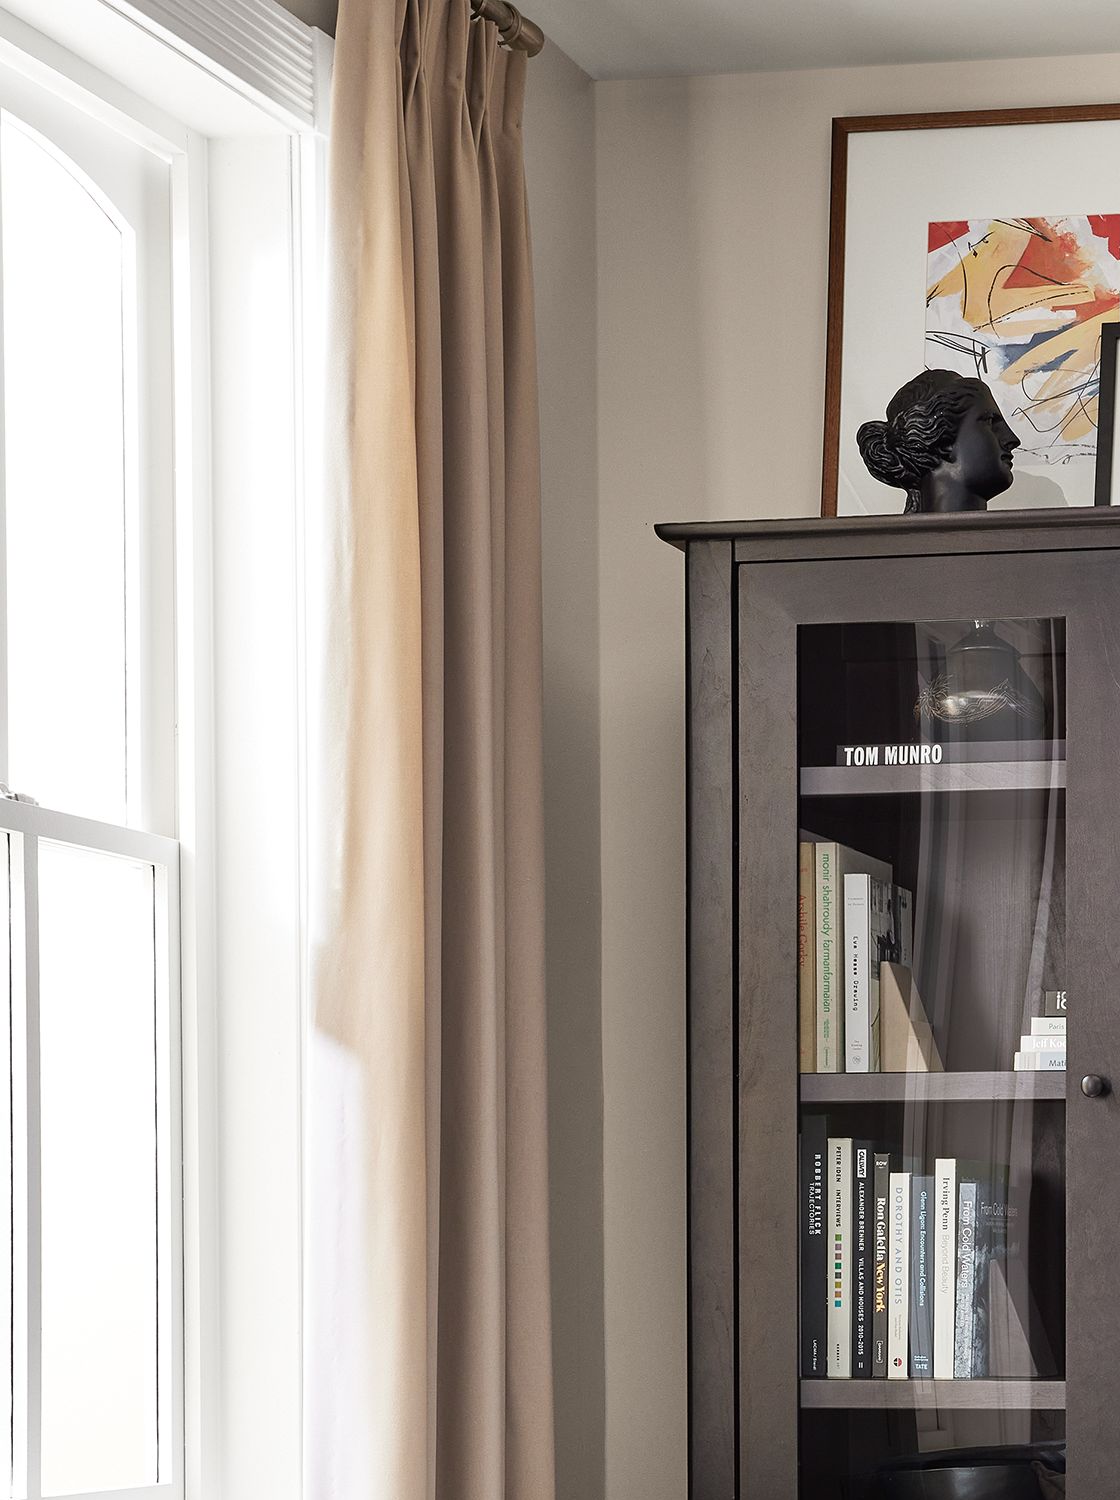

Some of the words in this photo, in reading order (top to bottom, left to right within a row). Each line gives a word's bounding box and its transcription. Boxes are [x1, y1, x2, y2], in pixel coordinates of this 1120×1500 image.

[844, 746, 878, 766] TOM
[884, 744, 943, 765] MUNRO
[822, 853, 832, 881] monir
[821, 883, 832, 936] shahroudy
[822, 939, 833, 1012] farmanfarmaian
[1032, 1038, 1048, 1048] Jeff
[941, 1177, 951, 1205] Irving
[877, 1197, 886, 1220] Ron
[895, 1187, 903, 1243] DOROTHY
[942, 1207, 950, 1230] Penn
[962, 1200, 972, 1225] From
[876, 1222, 886, 1261] Galella
[940, 1234, 950, 1264] Beyond
[961, 1228, 972, 1251] Cold
[876, 1262, 885, 1285] New
[895, 1248, 903, 1273] AND
[961, 1254, 971, 1288] Waters
[894, 1278, 902, 1305] OTIS
[939, 1266, 949, 1294] Beauty
[876, 1285, 885, 1313] York
